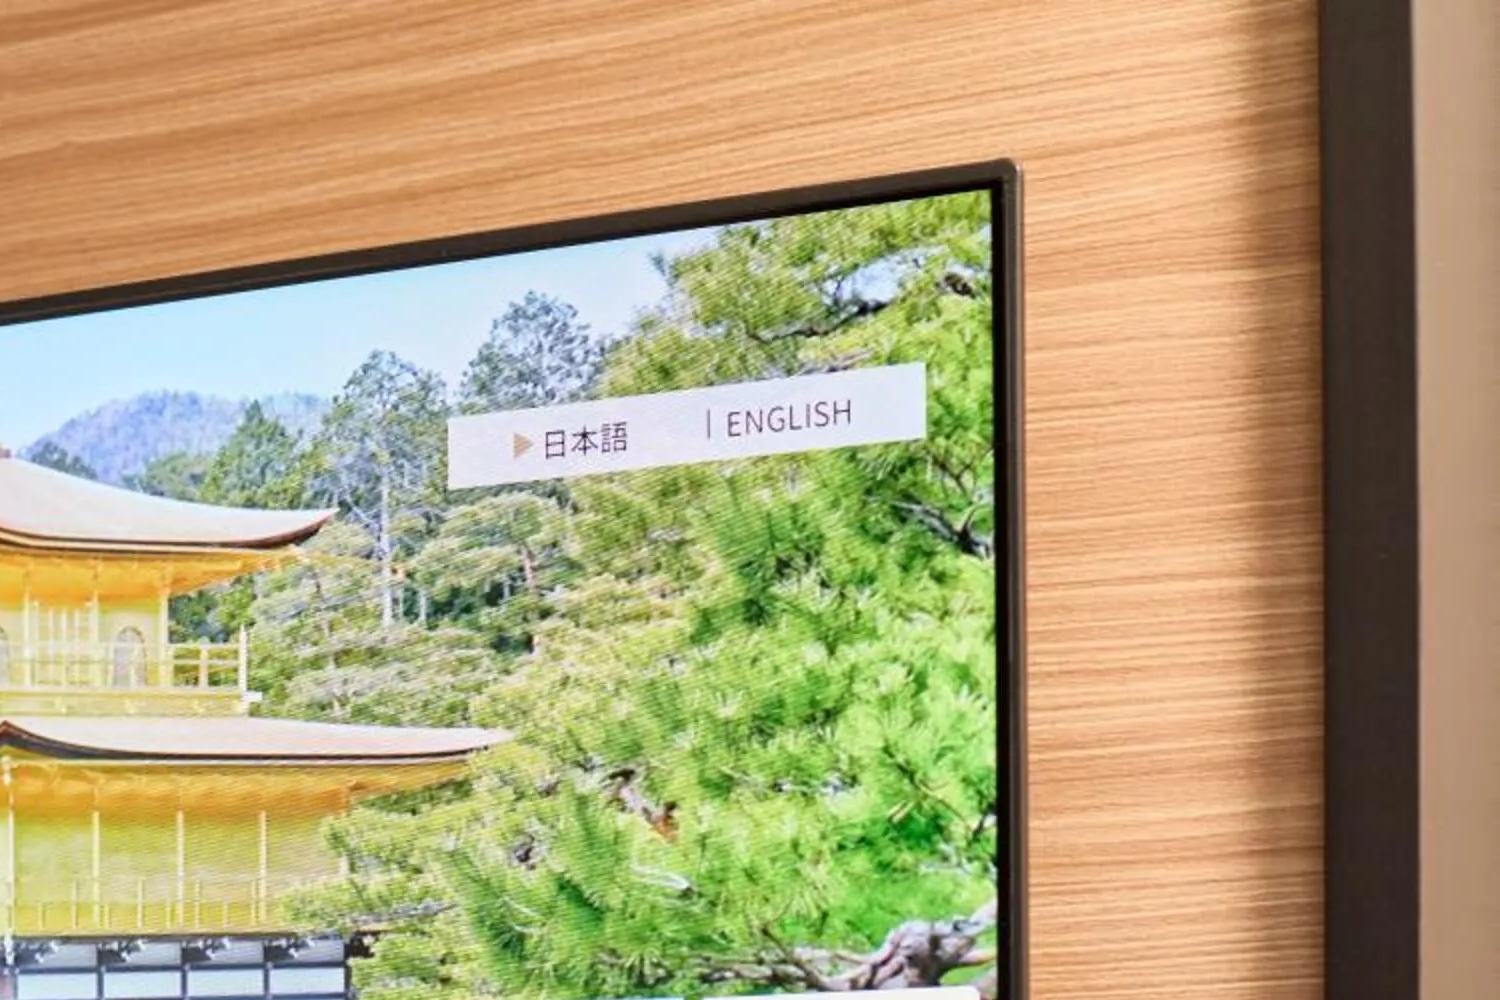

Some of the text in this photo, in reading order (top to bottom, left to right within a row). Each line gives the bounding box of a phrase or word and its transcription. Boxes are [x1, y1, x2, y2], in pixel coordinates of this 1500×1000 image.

[544, 399, 852, 459] 日本語 ENGLISH
